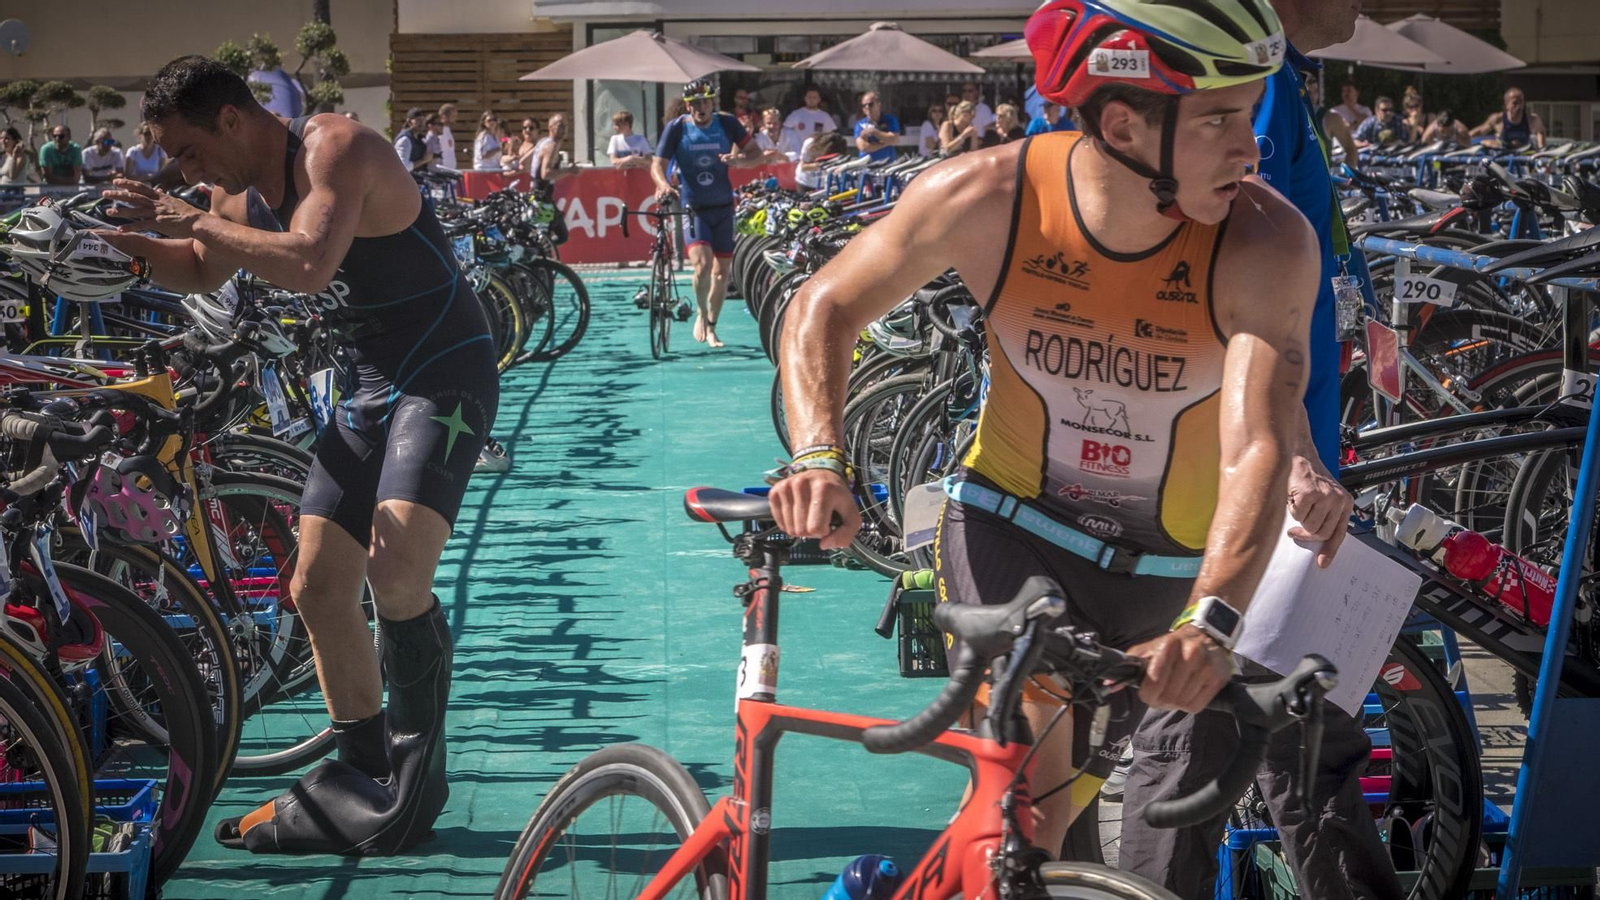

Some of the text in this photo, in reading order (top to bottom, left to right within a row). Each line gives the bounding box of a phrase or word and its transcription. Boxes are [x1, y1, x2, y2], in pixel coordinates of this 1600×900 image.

[1111, 58, 1138, 71] 293
[1260, 172, 1272, 181] ITU
[83, 243, 99, 251] 344
[1402, 280, 1441, 300] 290
[1025, 329, 1188, 392] RODRÍGUEZ
[1060, 418, 1132, 439] MONSECOR
[1080, 460, 1131, 475] FITNESS
